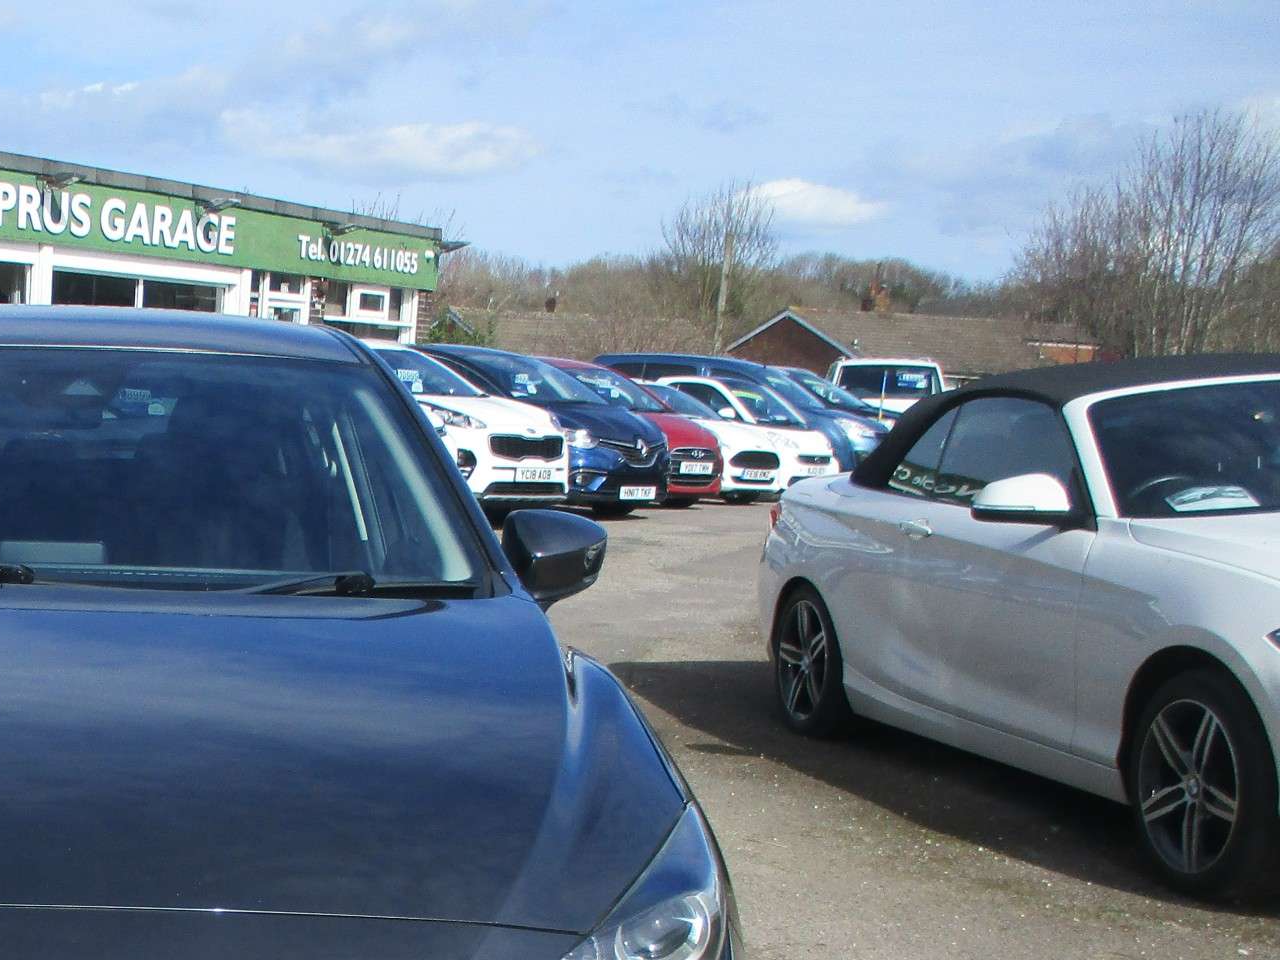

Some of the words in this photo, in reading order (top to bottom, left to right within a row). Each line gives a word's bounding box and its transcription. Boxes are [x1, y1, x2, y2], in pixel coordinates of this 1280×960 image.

[99, 196, 237, 256] GARAGE
[297, 233, 326, 262] Tel.
[329, 240, 370, 268] 01274
[373, 246, 419, 275] 611055
